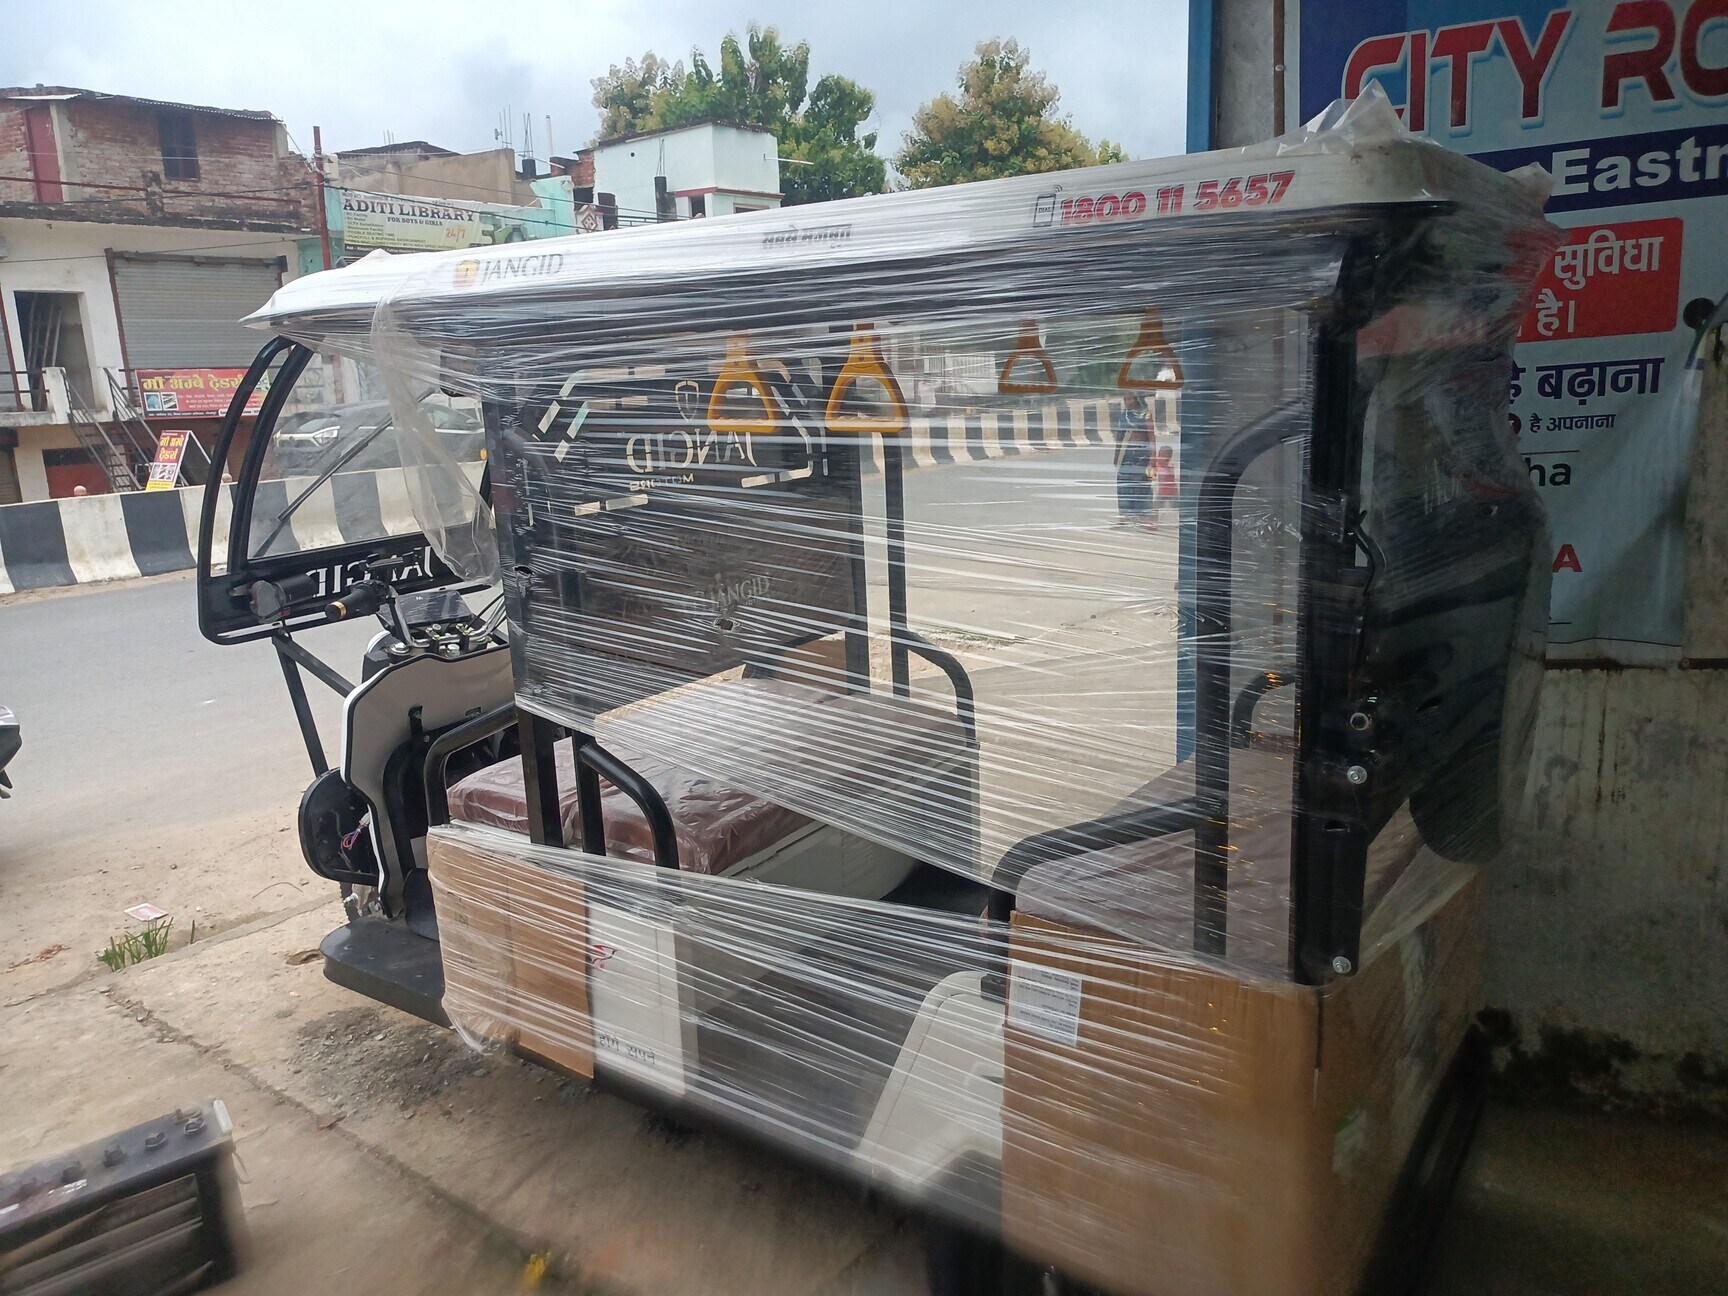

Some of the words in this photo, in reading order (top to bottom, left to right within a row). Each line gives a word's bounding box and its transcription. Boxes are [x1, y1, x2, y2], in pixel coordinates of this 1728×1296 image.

[1343, 9, 1573, 133] CITY
[343, 197, 397, 215] ADITI
[398, 203, 475, 222] LIBRARY
[1060, 191, 1147, 227] 1800
[1156, 183, 1185, 217] 11
[1193, 169, 1295, 212] 5657
[425, 219, 443, 227] GIRLS
[445, 226, 466, 242] 24/7
[480, 253, 564, 286] JANGID
[1554, 229, 1664, 290] सुविधा
[1536, 357, 1665, 405] बढ़ाना
[1529, 412, 1542, 433] है
[1546, 413, 1616, 432] अपनाना
